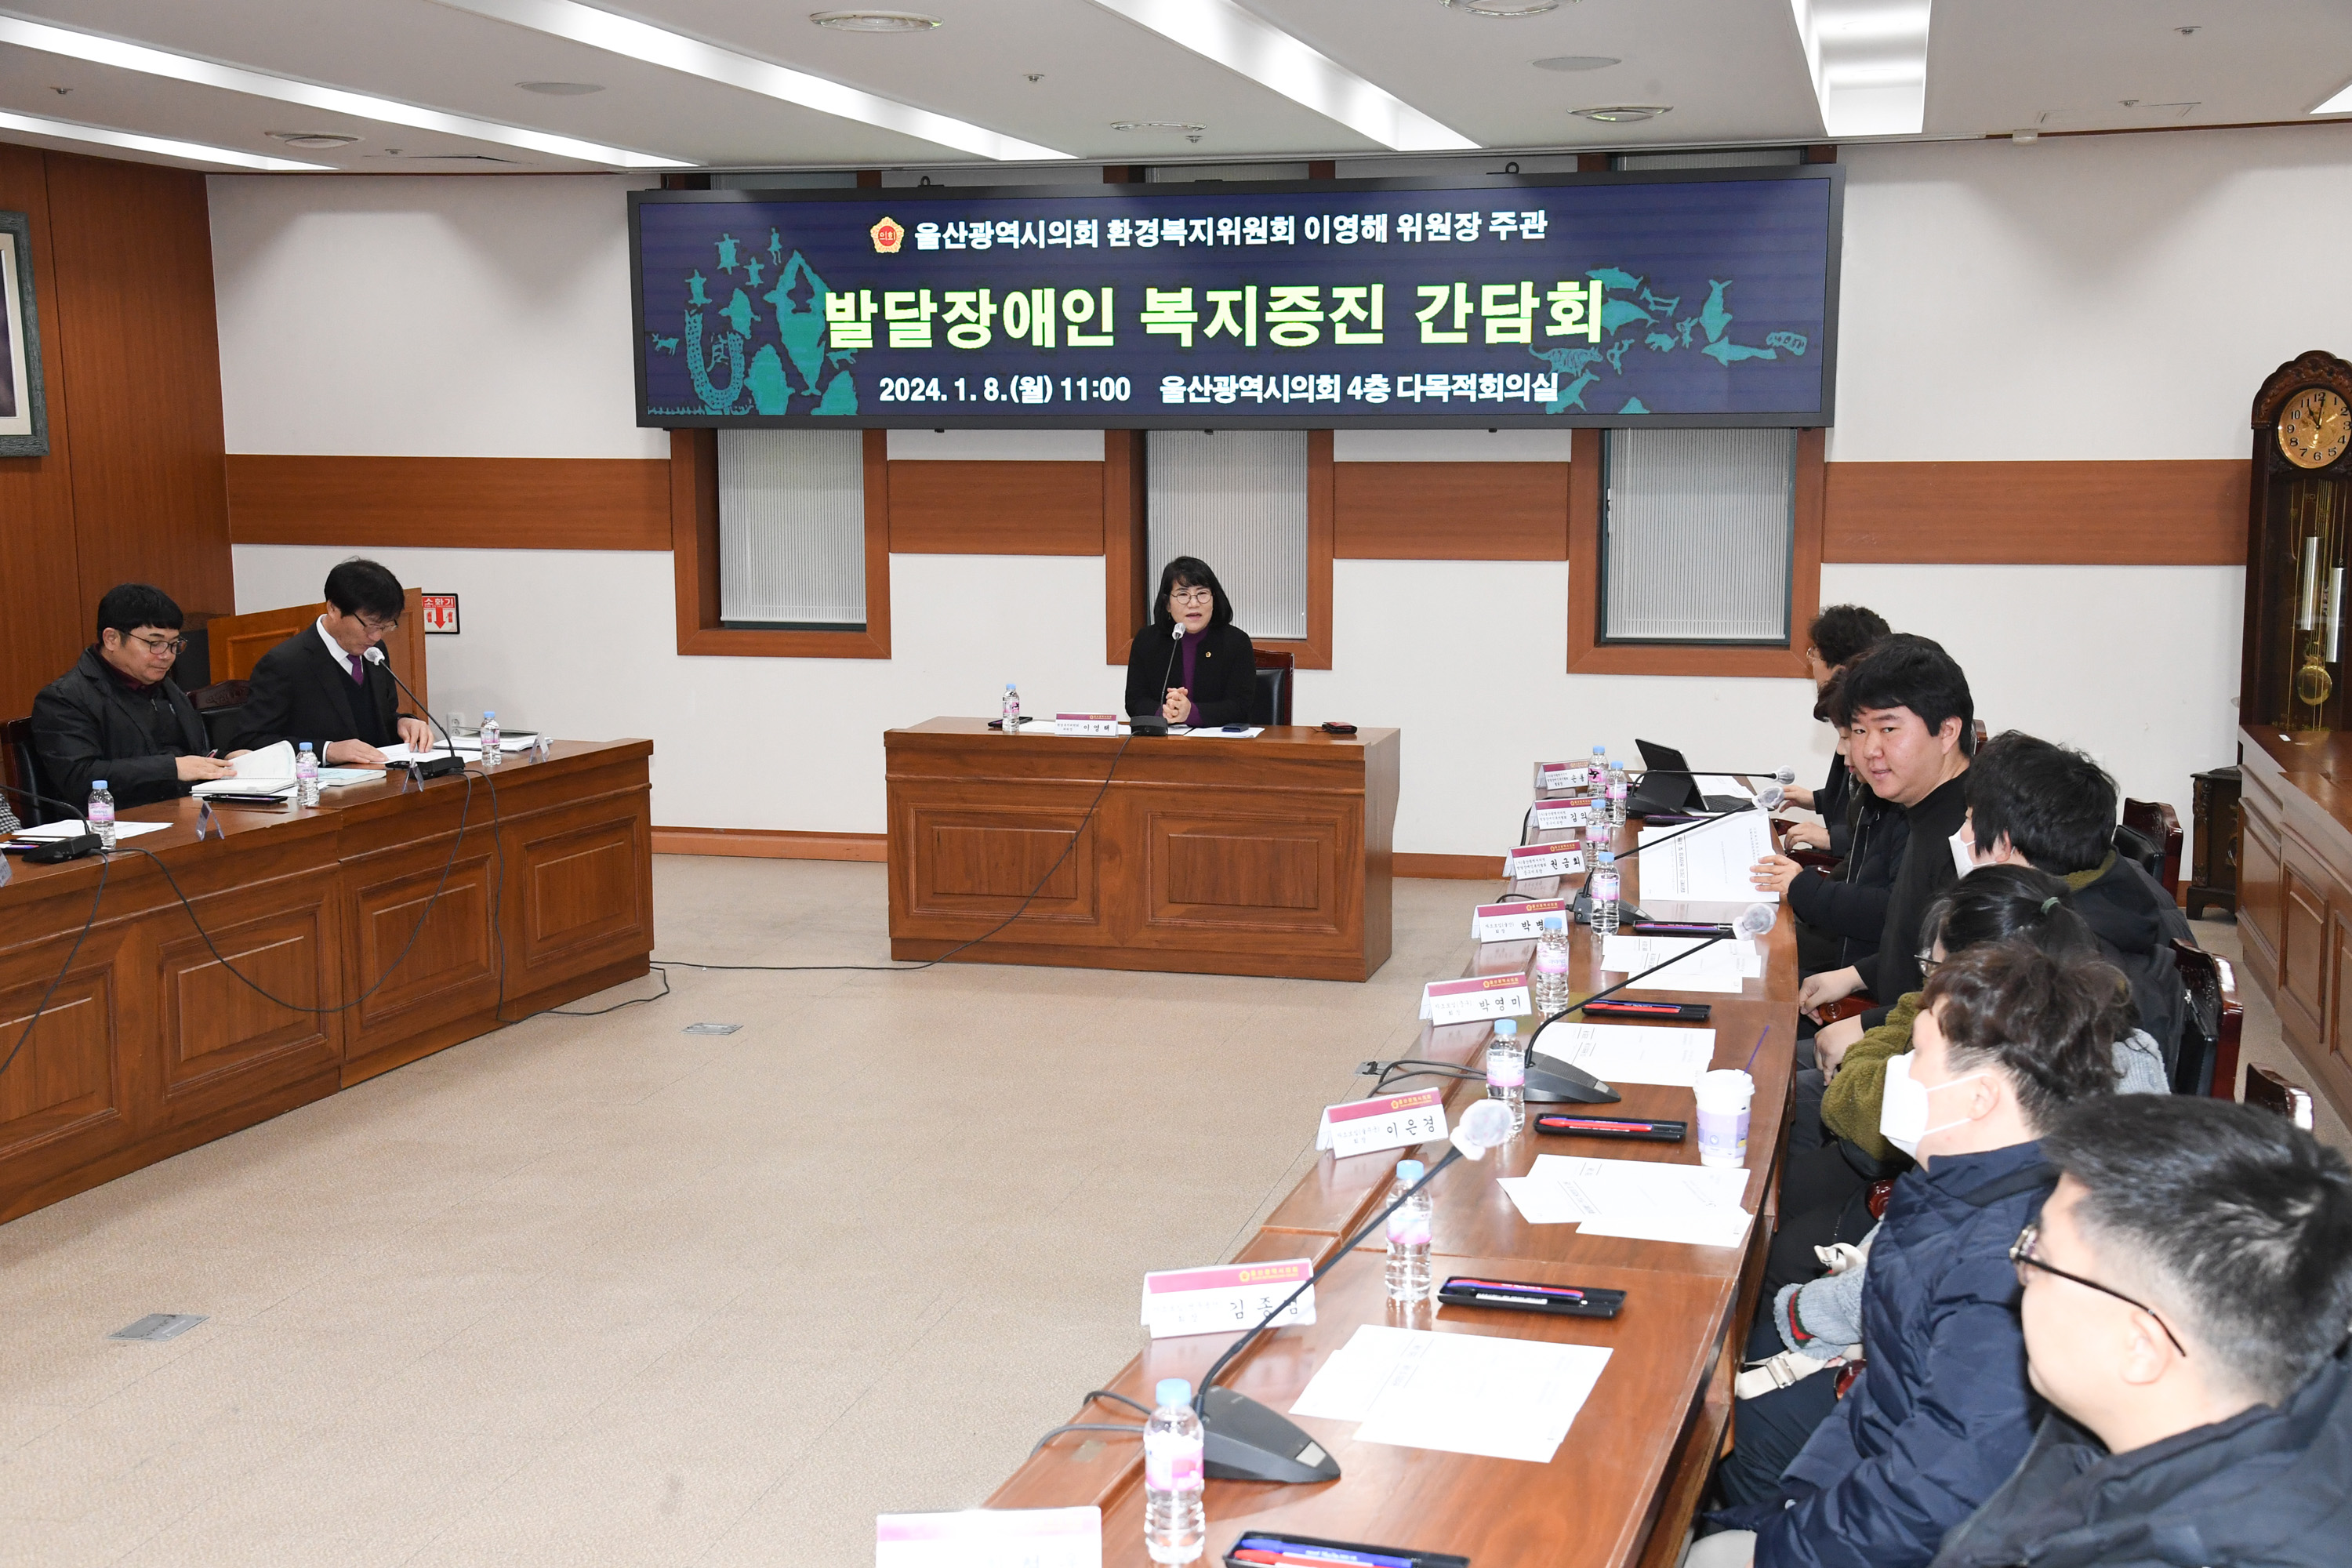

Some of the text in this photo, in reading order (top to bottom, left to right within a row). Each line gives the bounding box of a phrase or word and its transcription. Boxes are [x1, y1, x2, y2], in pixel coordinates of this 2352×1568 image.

[914, 209, 1548, 250] 울산광역시의회 환경복지위원회 이영해 위원장 주관
[879, 230, 896, 241] 의회
[825, 280, 1602, 349] 발달장애인 복지증진 간담회
[879, 372, 1559, 404] 2024. 1. 8.(월) 11:00 울산광역시의회 4층 다목적회의실
[2314, 392, 2326, 402] 12
[2301, 397, 2310, 408] 11
[2291, 410, 2301, 419] 10
[2340, 407, 2349, 416] 2
[2287, 424, 2295, 434] 9
[2343, 421, 2352, 430] 3
[2290, 437, 2299, 446] 8
[2337, 435, 2347, 444] 4
[2299, 448, 2308, 457] 7
[2328, 447, 2337, 456] 5
[2314, 452, 2321, 461] 6
